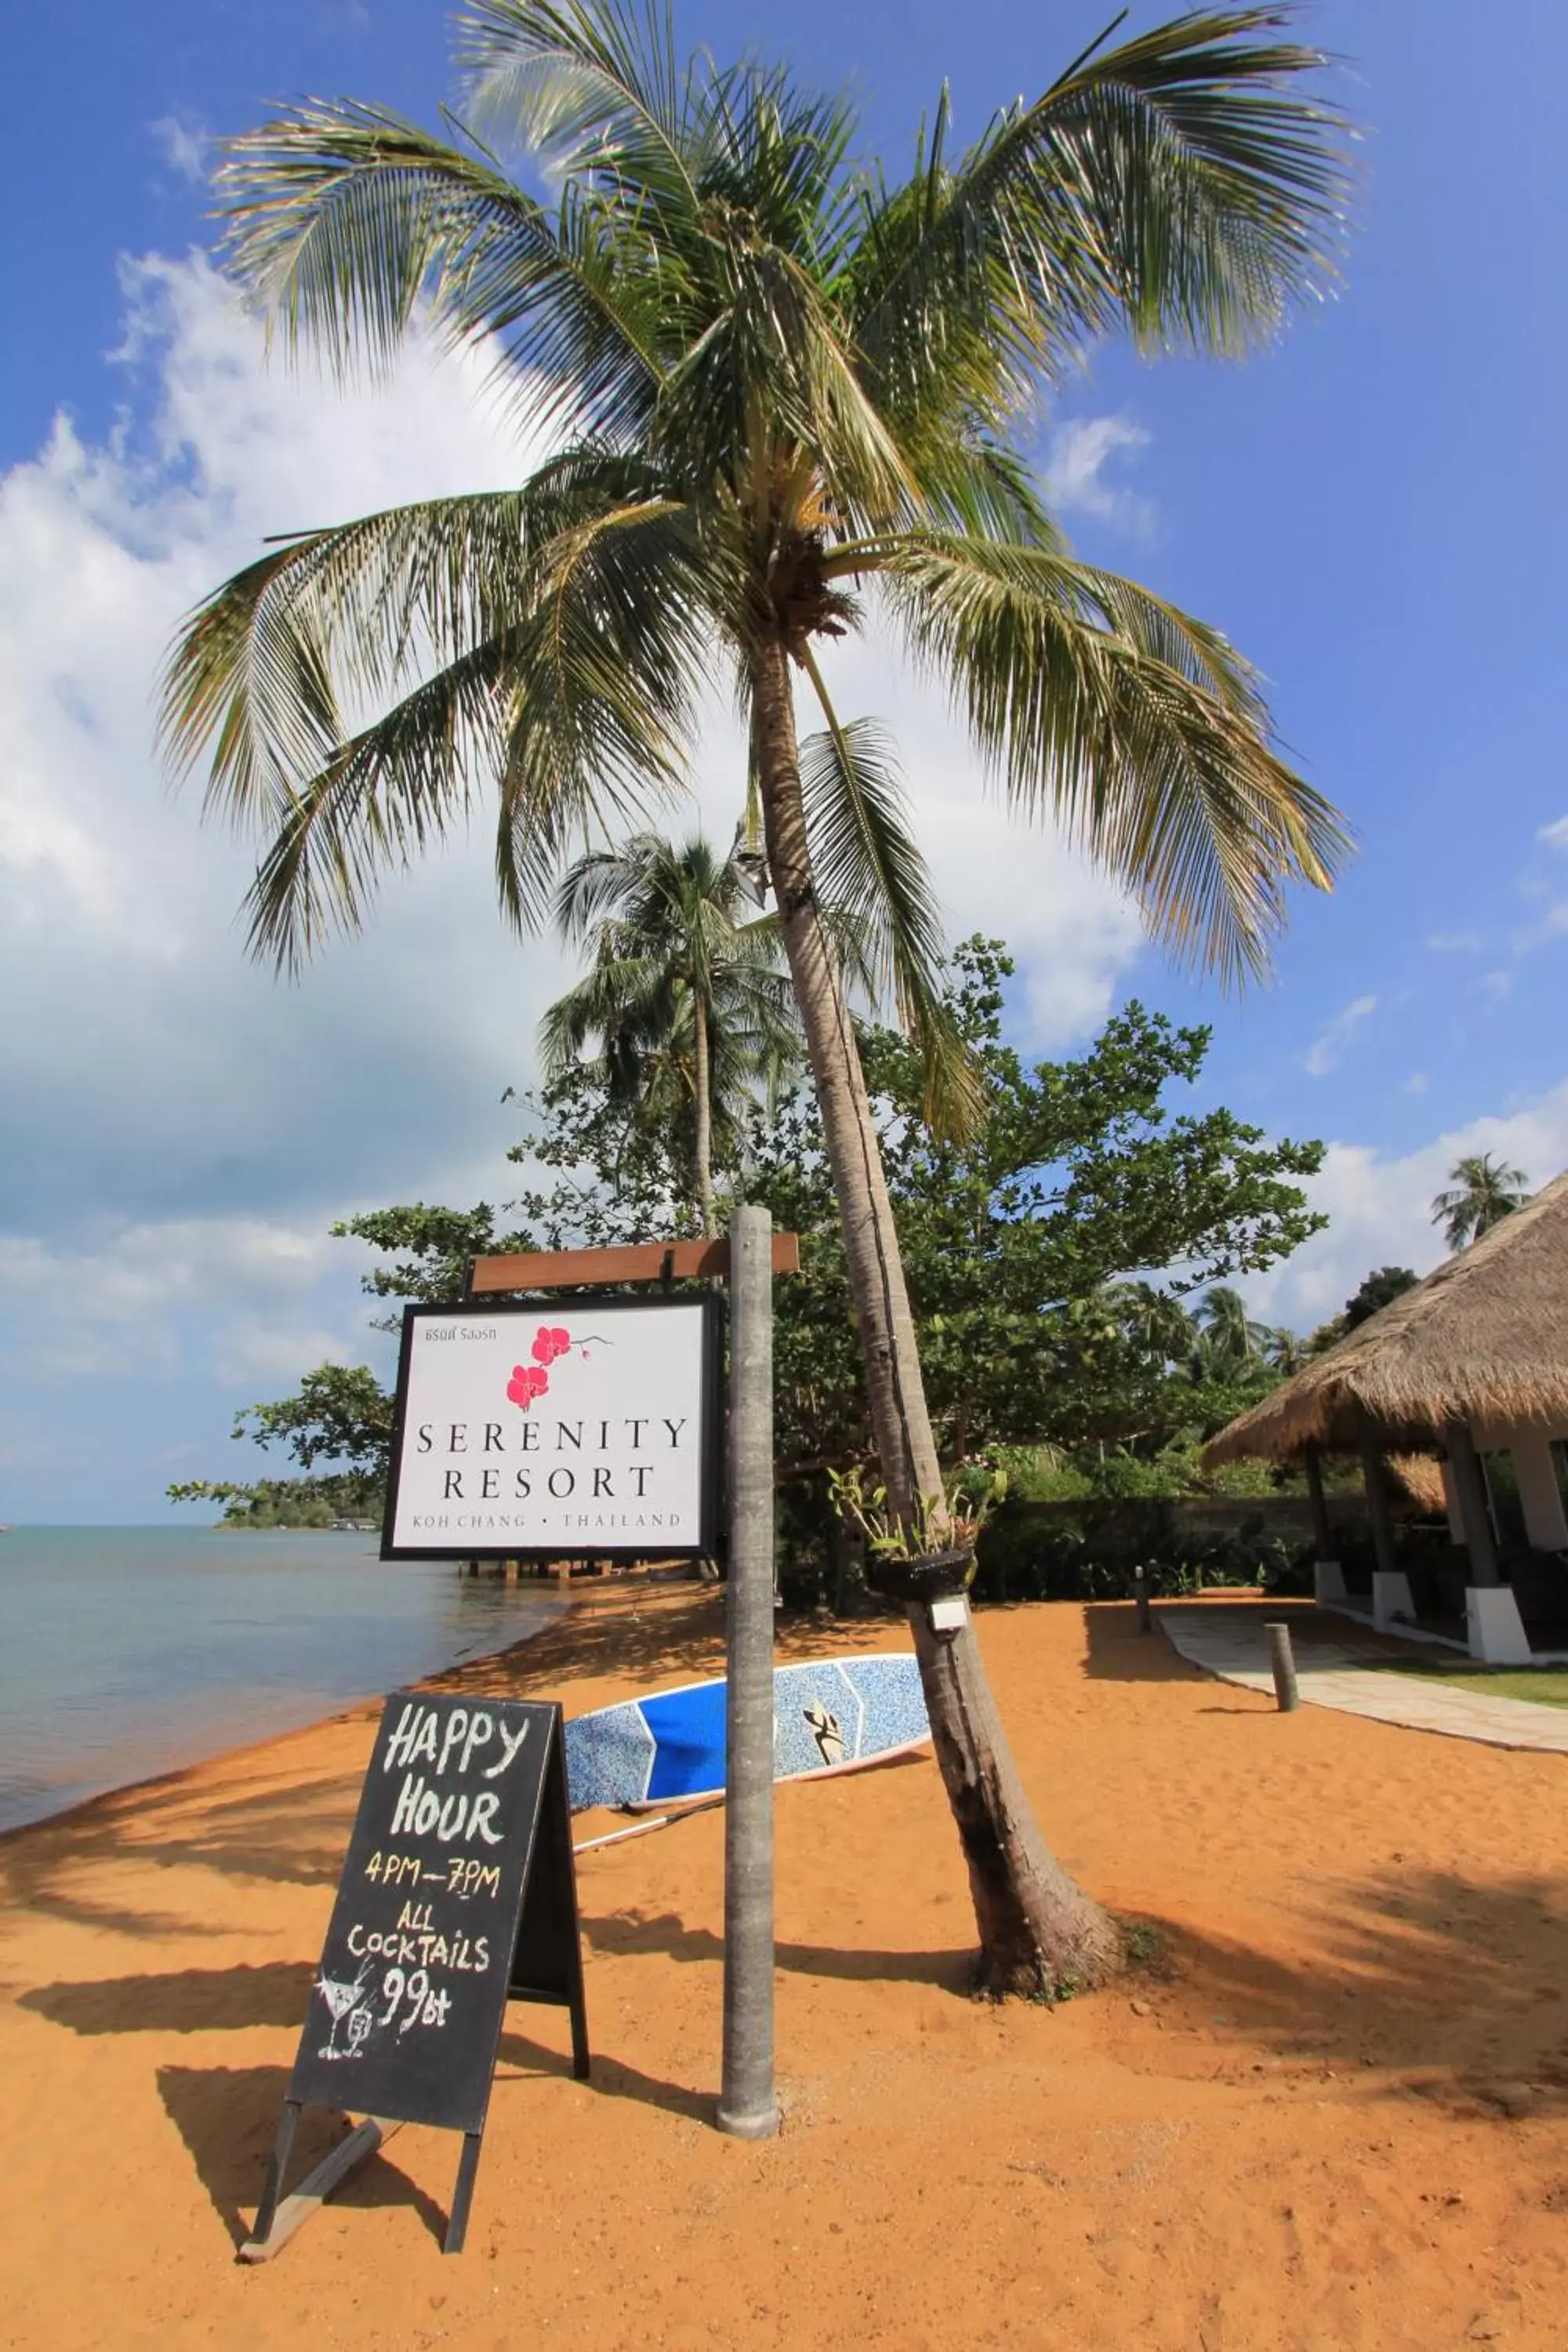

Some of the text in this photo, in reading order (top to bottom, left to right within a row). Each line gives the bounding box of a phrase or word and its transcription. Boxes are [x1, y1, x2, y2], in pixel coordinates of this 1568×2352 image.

[416, 1417, 687, 1453] SERENITY
[442, 1467, 654, 1499] RESORT
[413, 1513, 681, 1528] KOH CHANG THAILAND
[383, 1703, 531, 1780] HAPPY
[390, 1772, 505, 1845] HOUR
[396, 1900, 435, 1932] ALL
